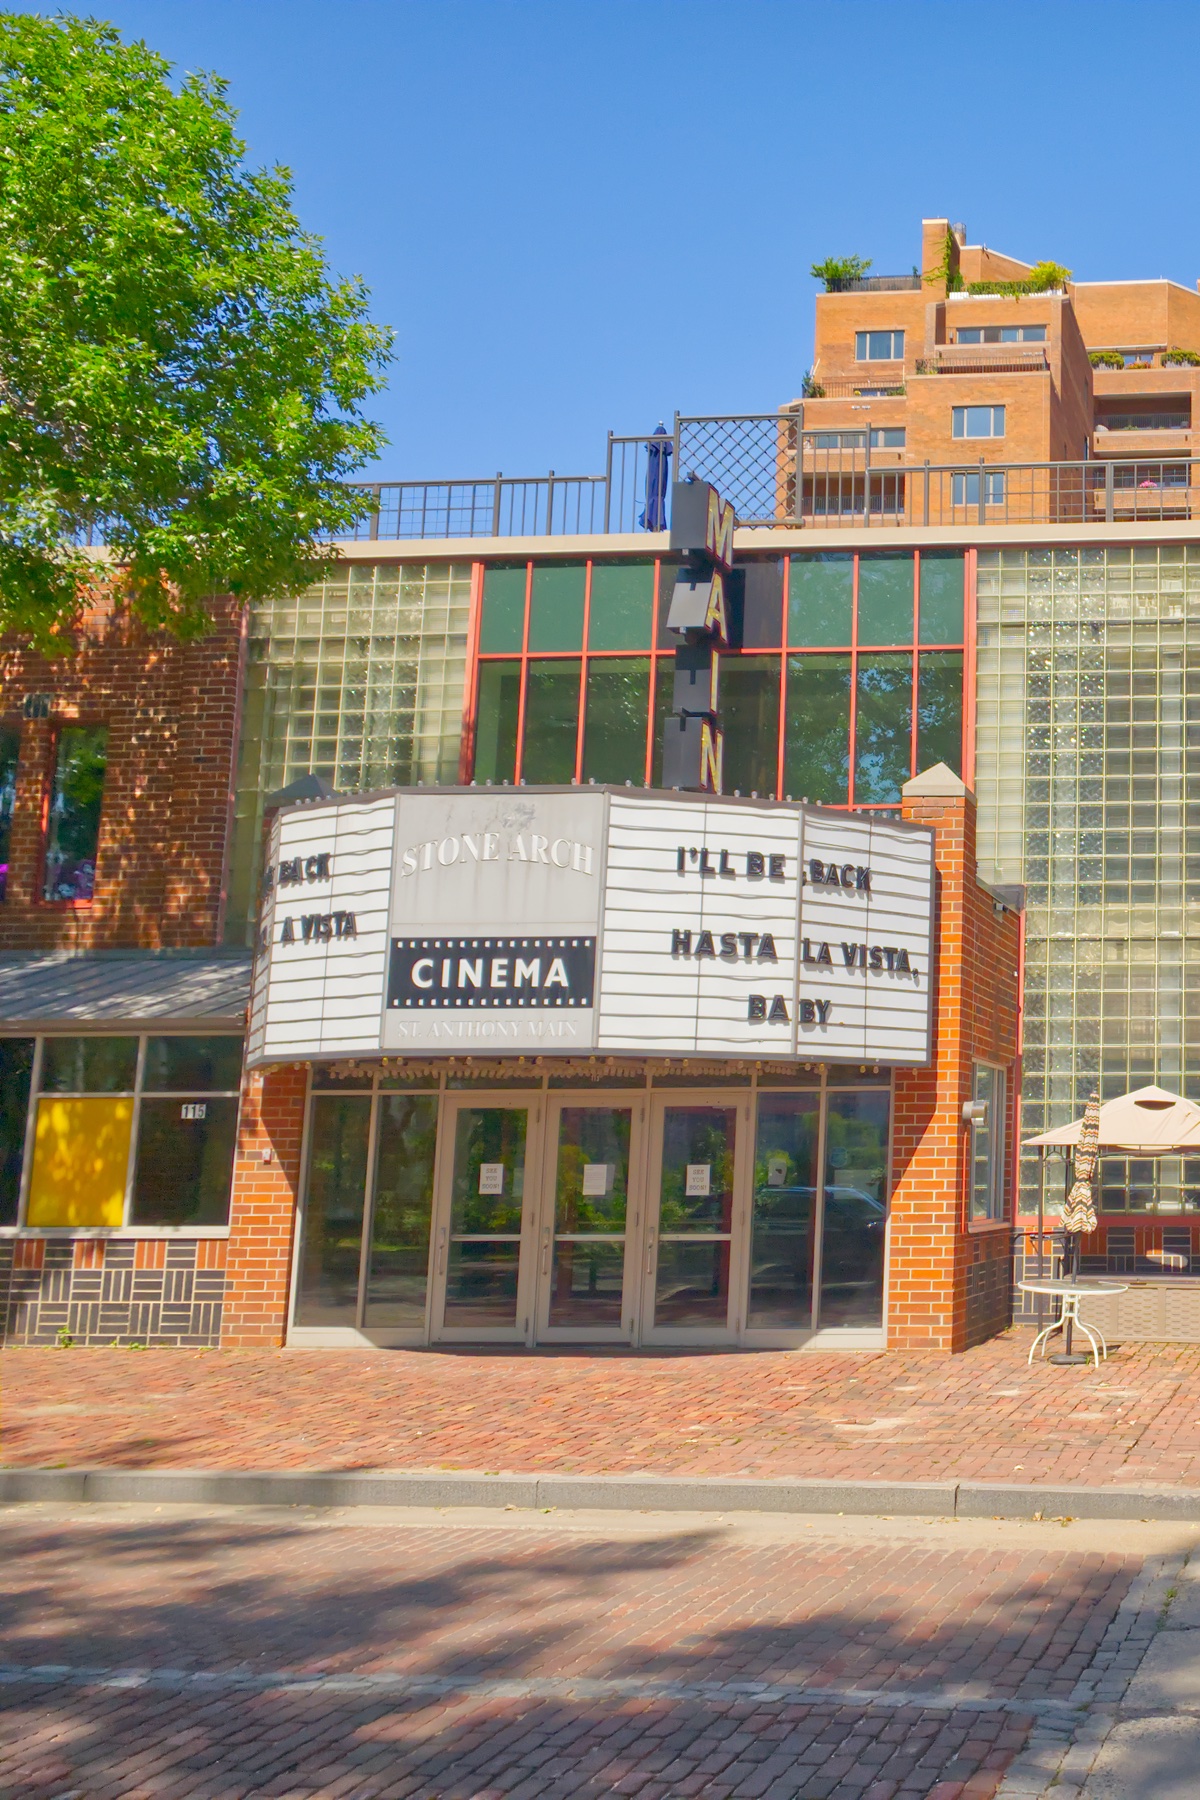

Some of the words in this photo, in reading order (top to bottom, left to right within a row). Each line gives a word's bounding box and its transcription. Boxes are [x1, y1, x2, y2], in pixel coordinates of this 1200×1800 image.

[698, 484, 736, 795] MAIN
[279, 852, 331, 882] BACK
[401, 831, 500, 878] STONE
[507, 832, 593, 877] ARCH
[676, 846, 736, 877] I'LL
[746, 851, 786, 877] BE
[809, 858, 871, 892] BACK
[301, 910, 358, 941] VISTA
[670, 929, 778, 960] HASTA
[802, 938, 833, 966] LA
[411, 957, 569, 989] CINEMA
[747, 994, 832, 1025] BABY
[399, 1021, 422, 1038] ST.
[428, 1021, 523, 1038] ANTHONY
[527, 1020, 579, 1037] MAIN
[183, 1106, 205, 1118] 115
